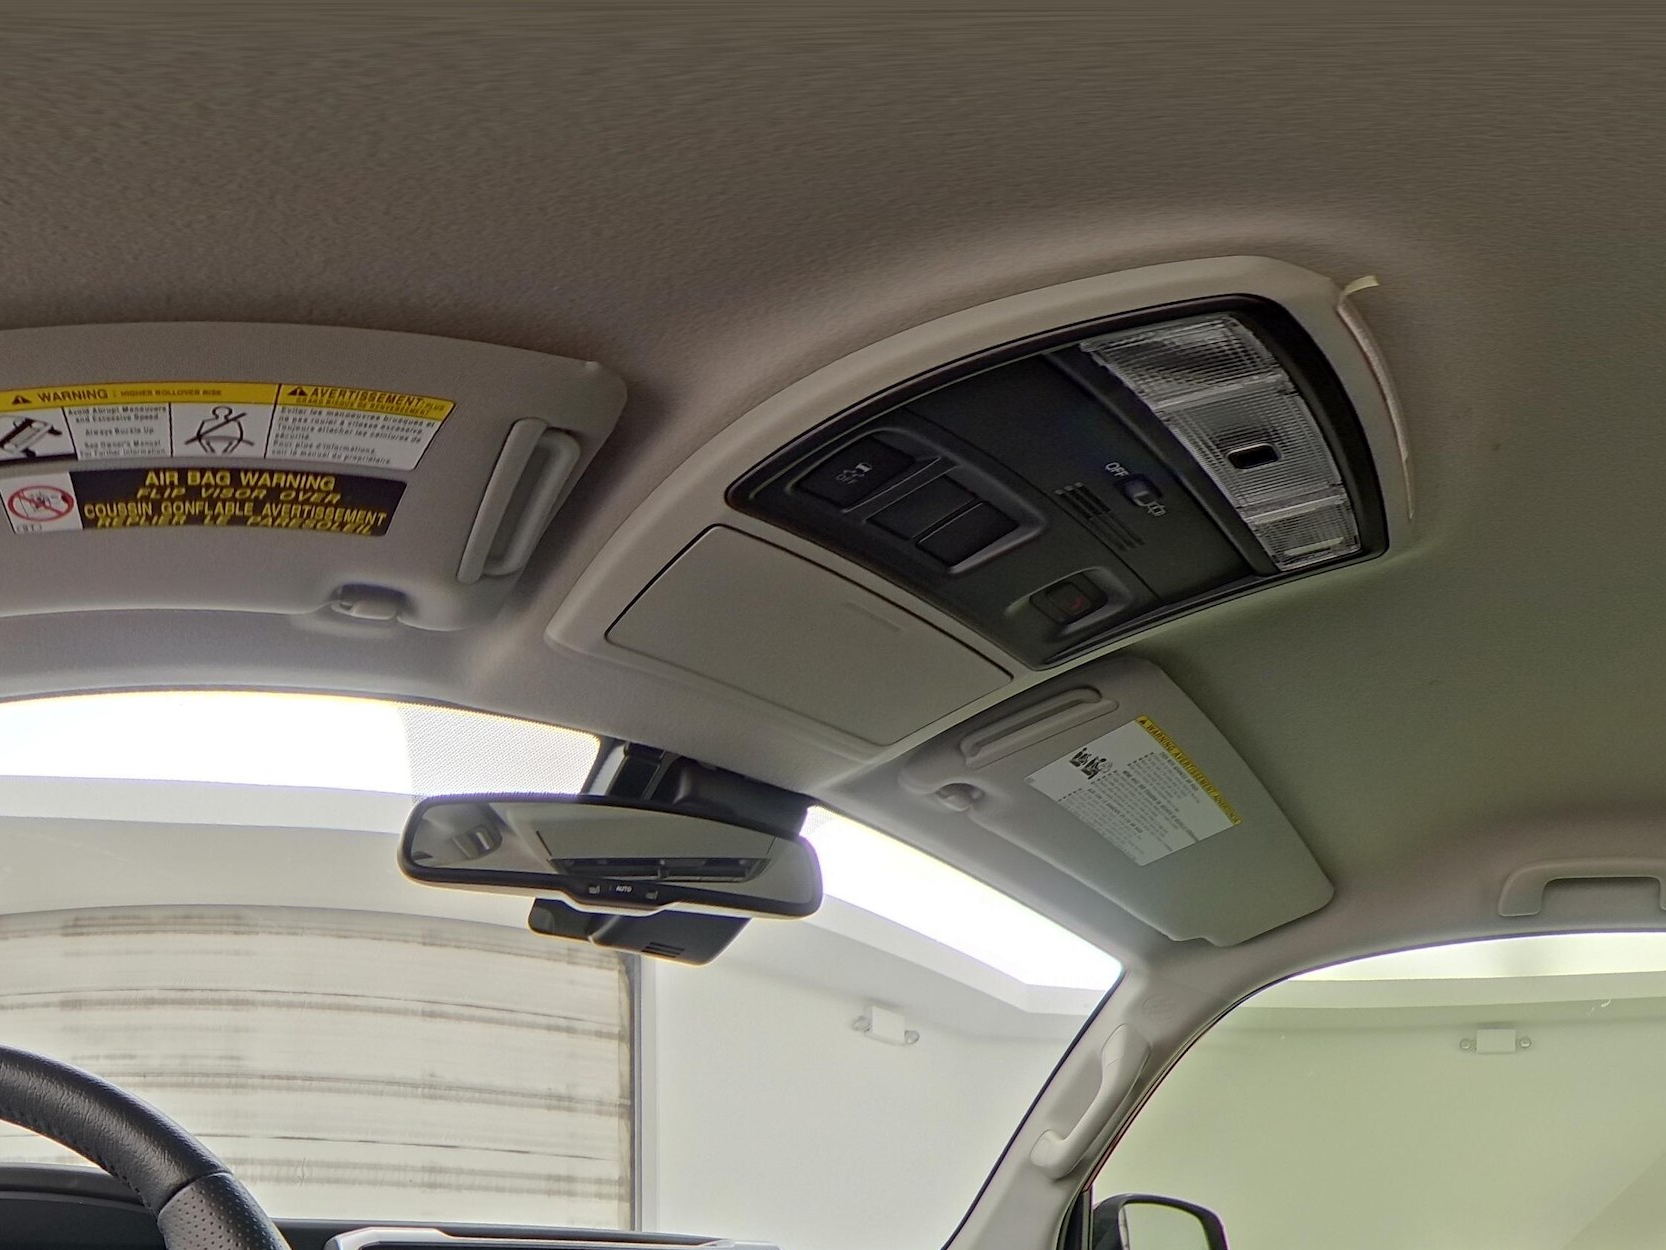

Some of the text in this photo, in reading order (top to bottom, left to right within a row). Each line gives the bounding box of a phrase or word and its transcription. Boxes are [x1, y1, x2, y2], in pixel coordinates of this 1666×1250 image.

[37, 388, 109, 403] WARNING
[311, 387, 423, 406] AVERTISSEMENT
[1104, 460, 1129, 479] OFF
[145, 470, 336, 491] AIR BAG WARNING
[136, 487, 342, 504] FLIP VISOR OVER
[84, 500, 388, 527] COUSSIN GONFLABLE AVERTISSEMENT
[203, 514, 231, 527] LE
[615, 885, 633, 893] AUTO
